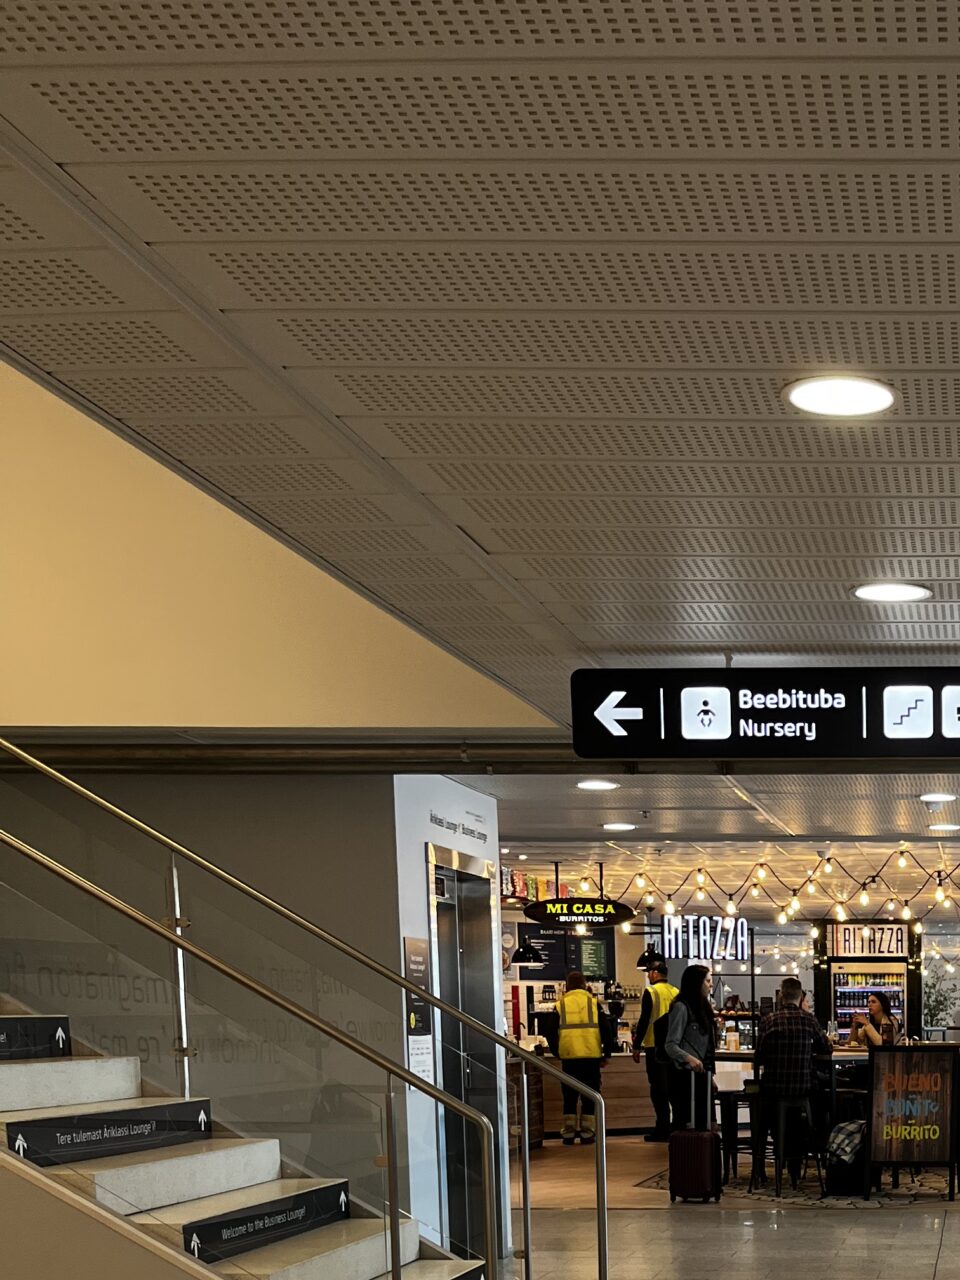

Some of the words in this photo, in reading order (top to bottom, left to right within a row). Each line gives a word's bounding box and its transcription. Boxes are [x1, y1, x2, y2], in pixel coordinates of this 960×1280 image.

[739, 688, 846, 709] Beebituba
[739, 718, 817, 741] Nursery
[546, 903, 569, 914] MI
[572, 903, 616, 914] CASA
[559, 915, 605, 923] BURRITOS
[843, 927, 904, 954] RITAZZA
[884, 1073, 941, 1091] BUENO
[56, 1132, 72, 1145] Tere
[73, 1127, 102, 1143] tulemast
[103, 1124, 129, 1139] Äriklassi
[883, 1125, 940, 1140] BURRITO
[221, 1224, 247, 1241] Welcome
[247, 1221, 254, 1234] to
[254, 1217, 264, 1231] the
[264, 1212, 287, 1229] Business
[286, 1204, 306, 1222] Lounge!
